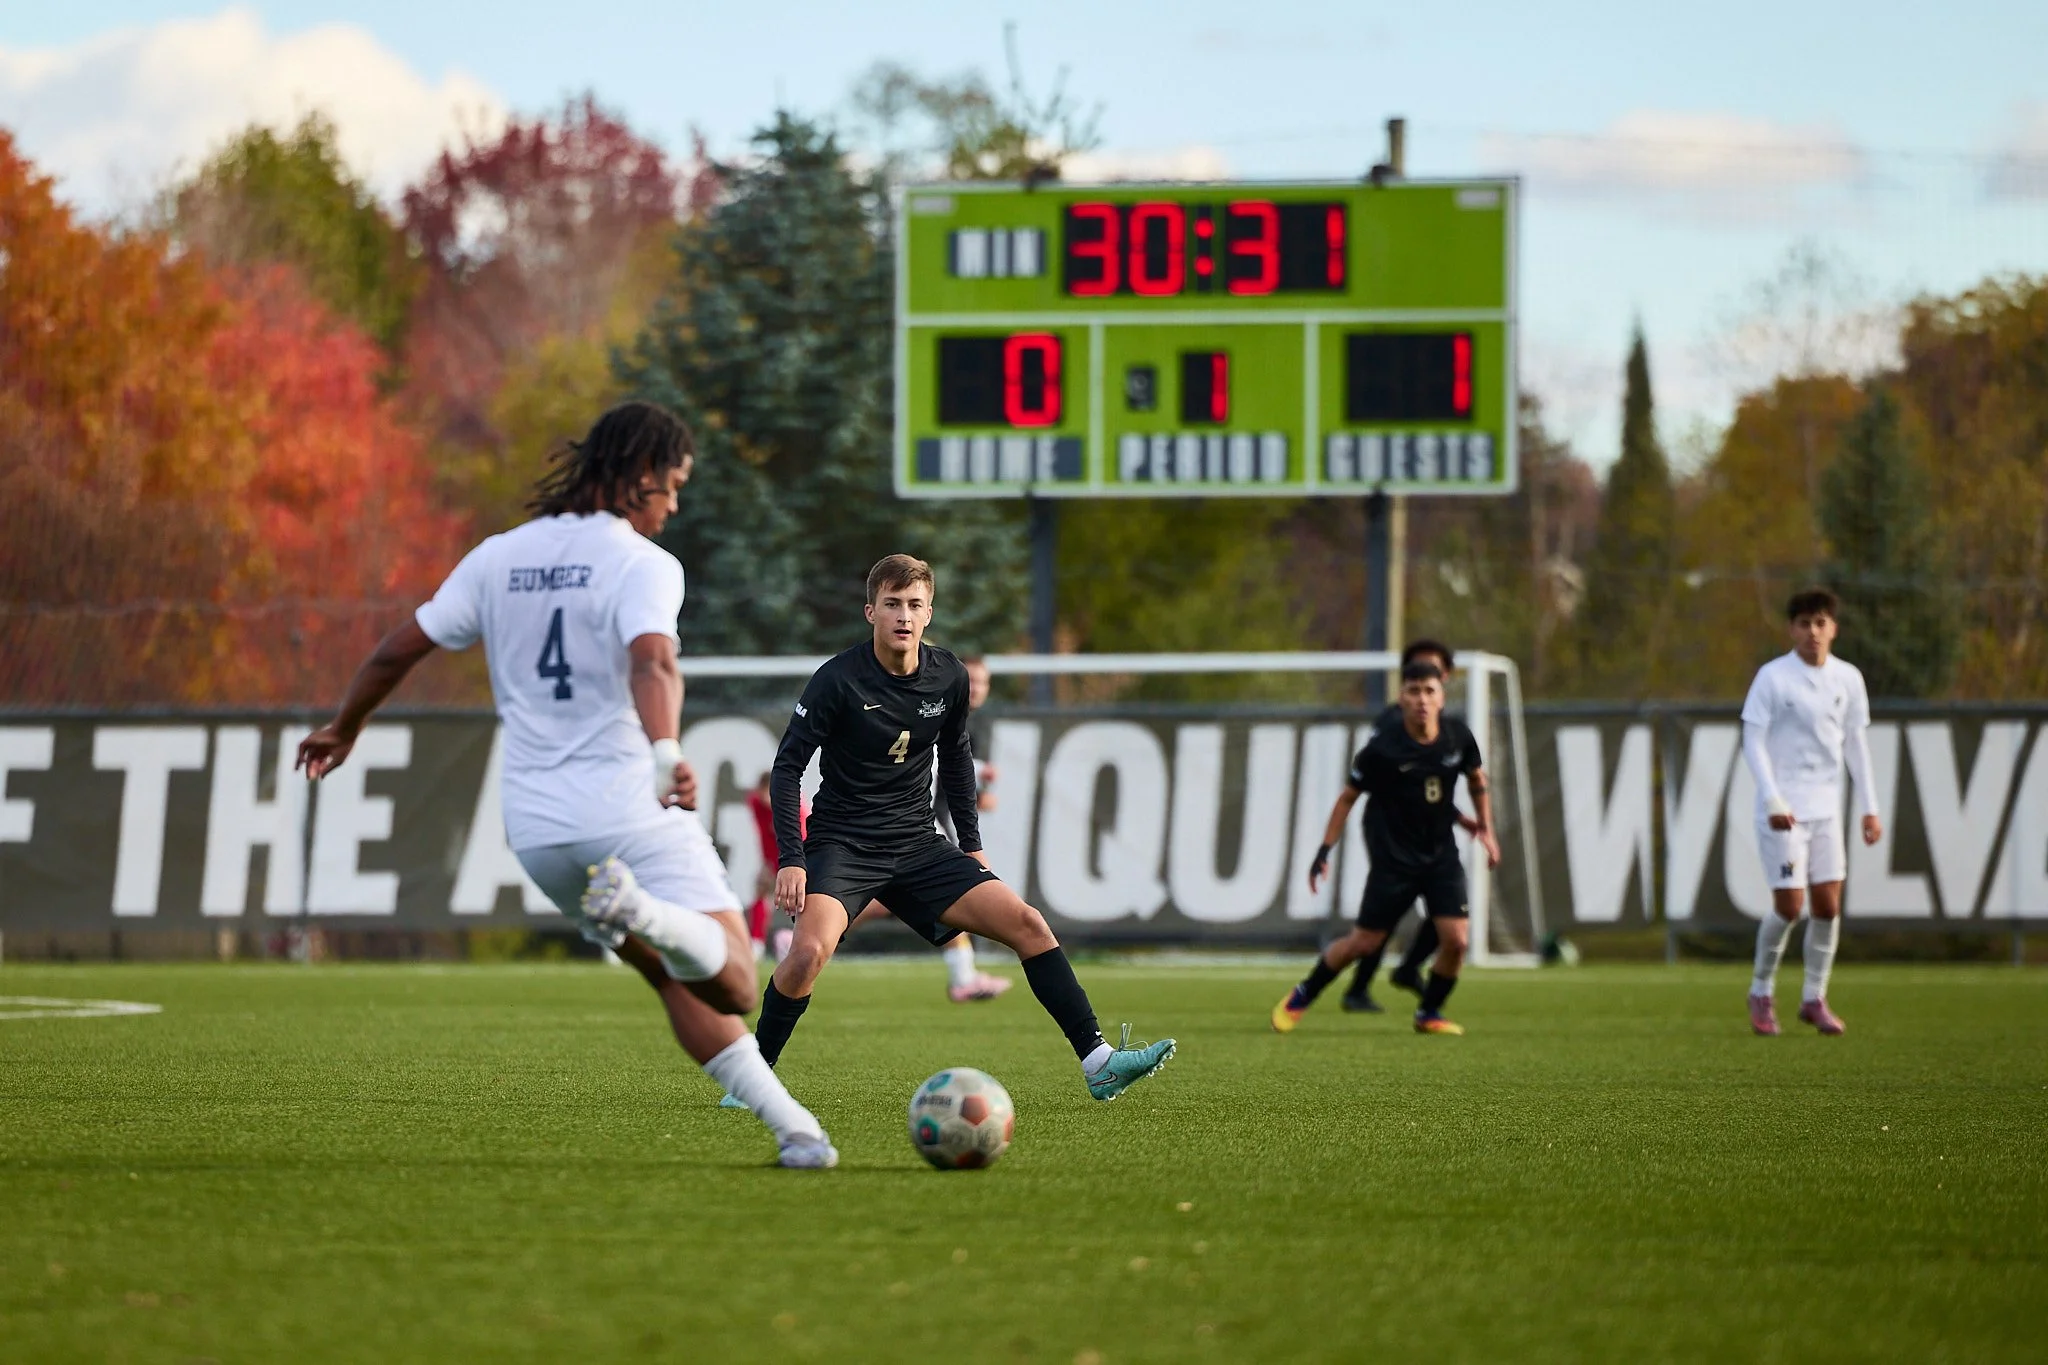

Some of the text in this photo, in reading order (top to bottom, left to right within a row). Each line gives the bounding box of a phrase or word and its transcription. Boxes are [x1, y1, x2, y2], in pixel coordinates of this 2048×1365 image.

[1070, 200, 1346, 296] 30:31
[1004, 332, 1062, 427] 0
[1211, 352, 1228, 422] 1
[1453, 333, 1471, 416] 1
[1328, 434, 1492, 482] GUESTS
[507, 565, 593, 593] HUMBER
[536, 607, 573, 700] 4
[887, 730, 911, 764] 4
[92, 725, 413, 917] THE
[450, 717, 1478, 922] AGQUI
[1424, 775, 1442, 804] 8
